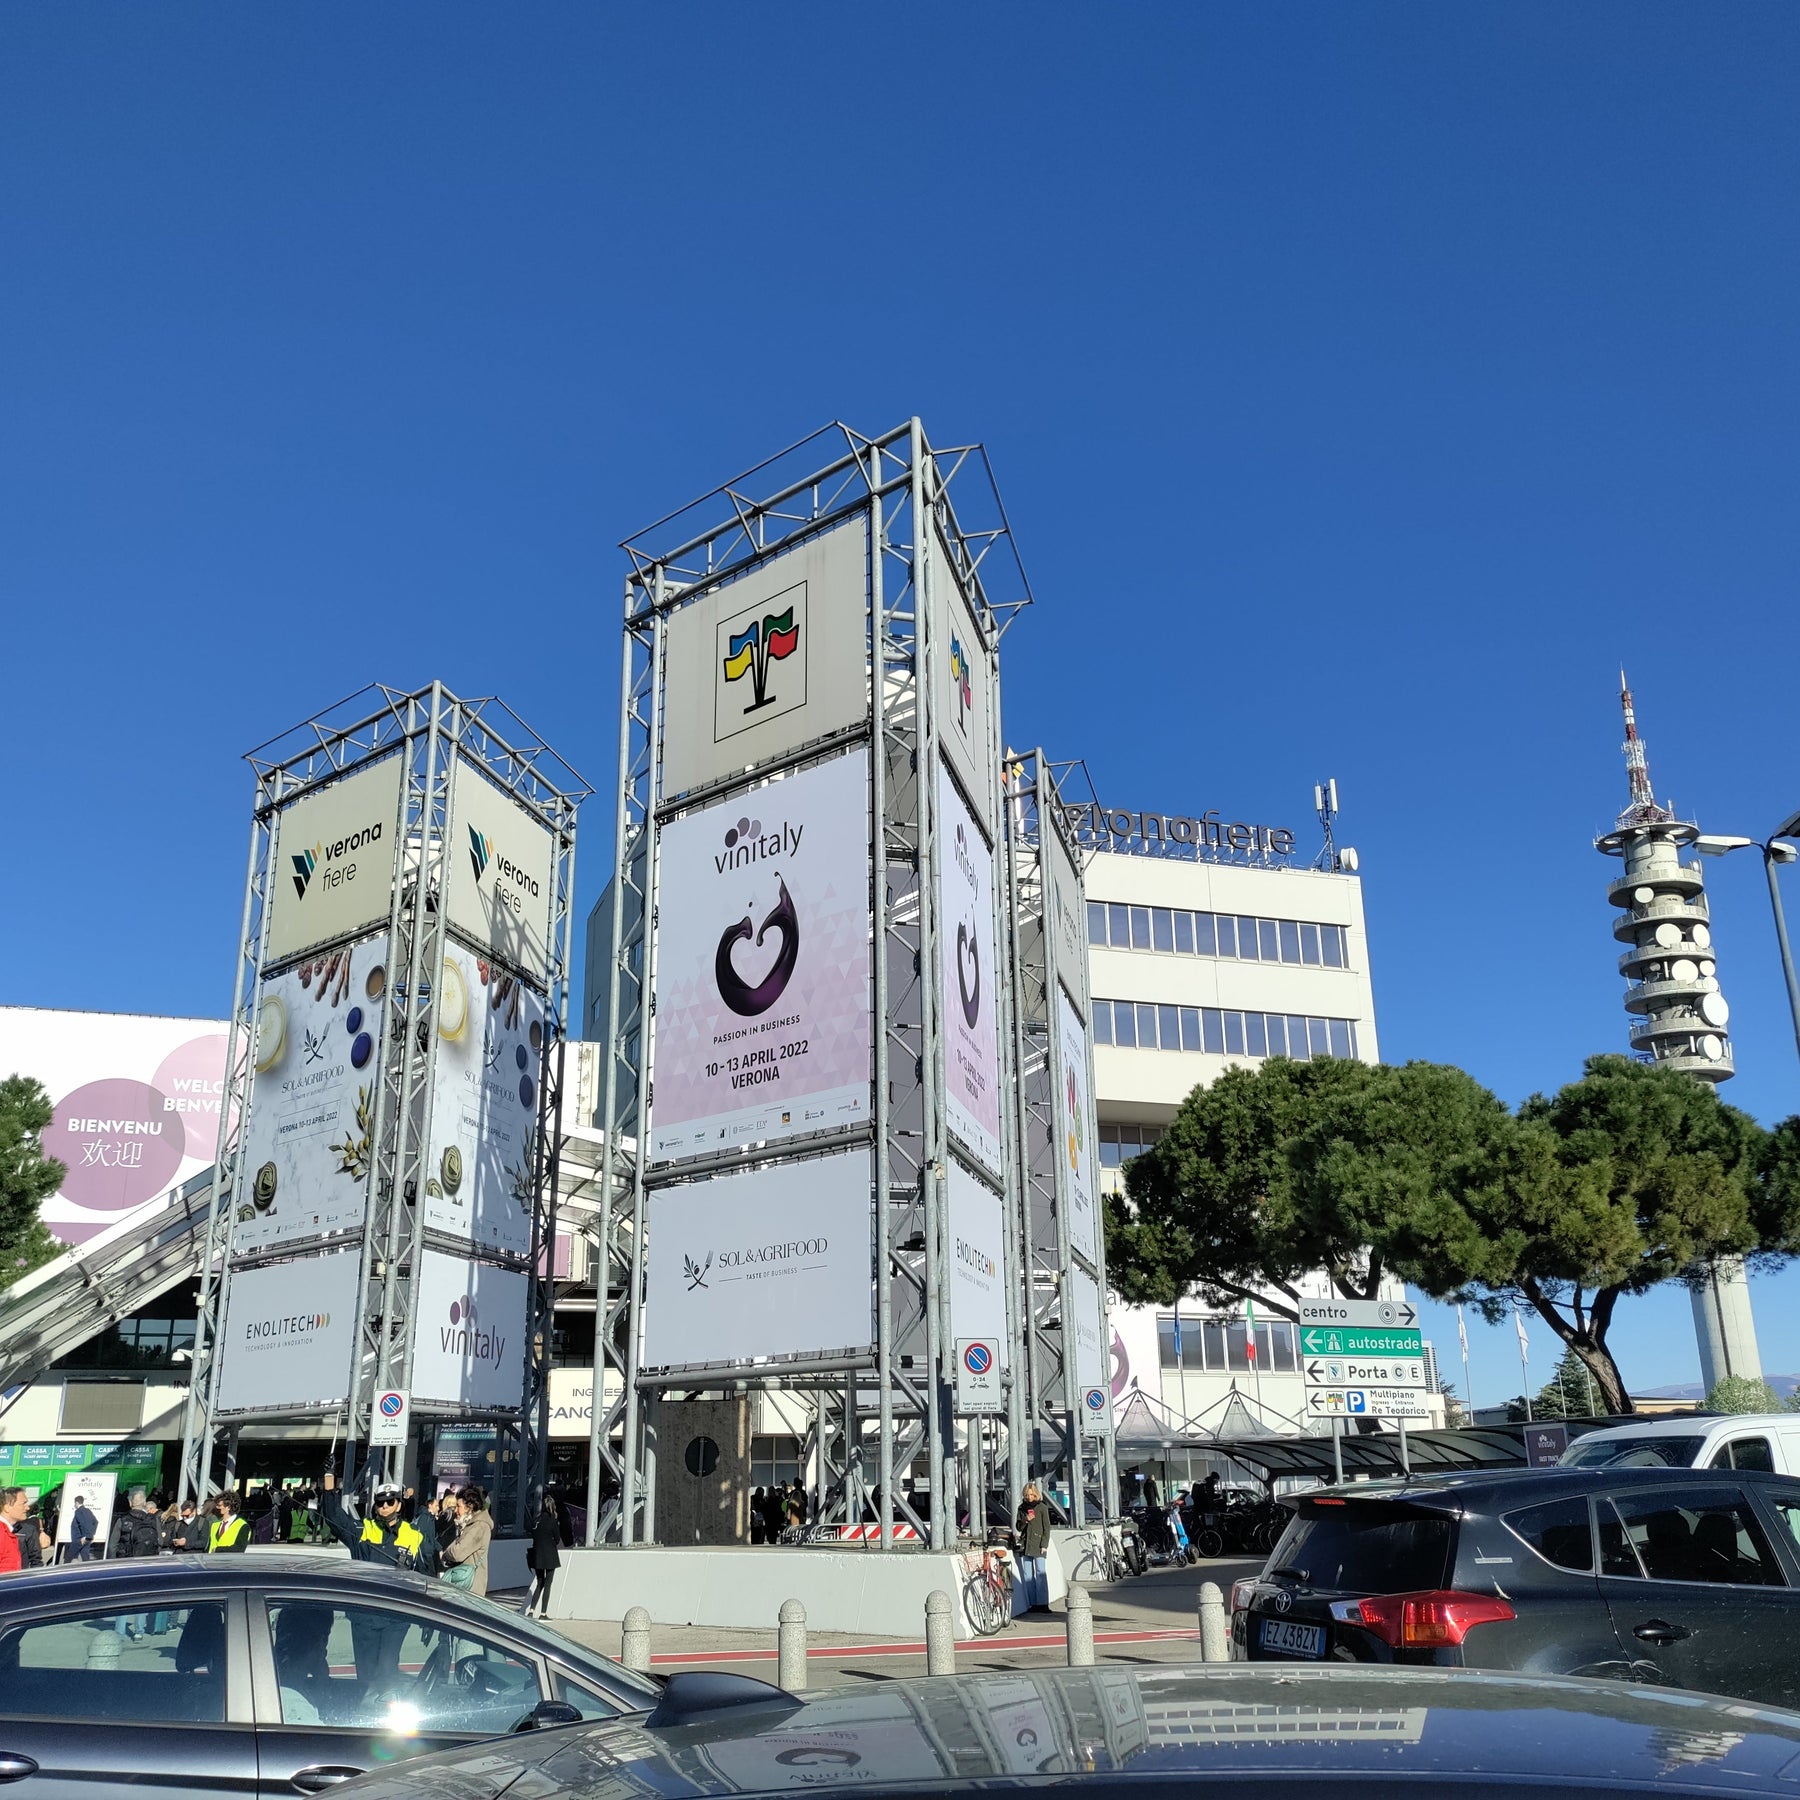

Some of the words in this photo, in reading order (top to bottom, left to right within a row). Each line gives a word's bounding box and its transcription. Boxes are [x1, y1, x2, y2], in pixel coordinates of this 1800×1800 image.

[325, 821, 383, 862] verona
[1066, 802, 1296, 855] eronafiere
[714, 821, 804, 874] vinitaly
[321, 861, 357, 892] fiere
[496, 852, 539, 898] verona
[954, 838, 979, 901] vinitaly
[495, 878, 522, 914] fiere
[713, 1028, 747, 1045] PASSION
[749, 1025, 758, 1035] IN
[760, 1014, 801, 1033] BUSINESS
[742, 1048, 777, 1068] APRIL
[780, 1040, 809, 1060] 2022
[173, 1078, 225, 1095] WELC
[281, 1064, 345, 1094] SOL&AGRIFOOD
[731, 1065, 780, 1089] VERONA
[163, 1097, 223, 1114] BENVE
[67, 1118, 163, 1136] BIENVENU
[279, 1123, 298, 1134] VERONA
[312, 1115, 326, 1125] APRIL
[326, 1111, 338, 1121] 2022
[79, 1138, 144, 1168] 欢迎
[718, 1237, 828, 1268] SOL&AGRIFOOD
[957, 1237, 989, 1275] ENOLITECH
[745, 1272, 763, 1280] TASTE
[771, 1267, 798, 1277] BUSINESS
[1302, 1305, 1348, 1319] centro
[246, 1314, 315, 1340] ENOLITECH
[245, 1342, 277, 1352] TECHNOLOGY
[282, 1338, 313, 1347] INNOVATION
[440, 1324, 506, 1371] vinitaly
[1347, 1336, 1420, 1350] autostrade
[1348, 1365, 1388, 1379] Porta
[1394, 1367, 1402, 1378] C
[1411, 1367, 1419, 1378] E
[572, 1388, 624, 1398] INGES
[1349, 1393, 1362, 1411] P
[1370, 1390, 1415, 1400] Multipiano
[1371, 1405, 1383, 1415] Re
[1385, 1406, 1426, 1415] Teodorico
[1537, 1438, 1556, 1449] vinitaly
[1265, 1621, 1280, 1645] EZ
[1282, 1625, 1318, 1652] 438ZX
